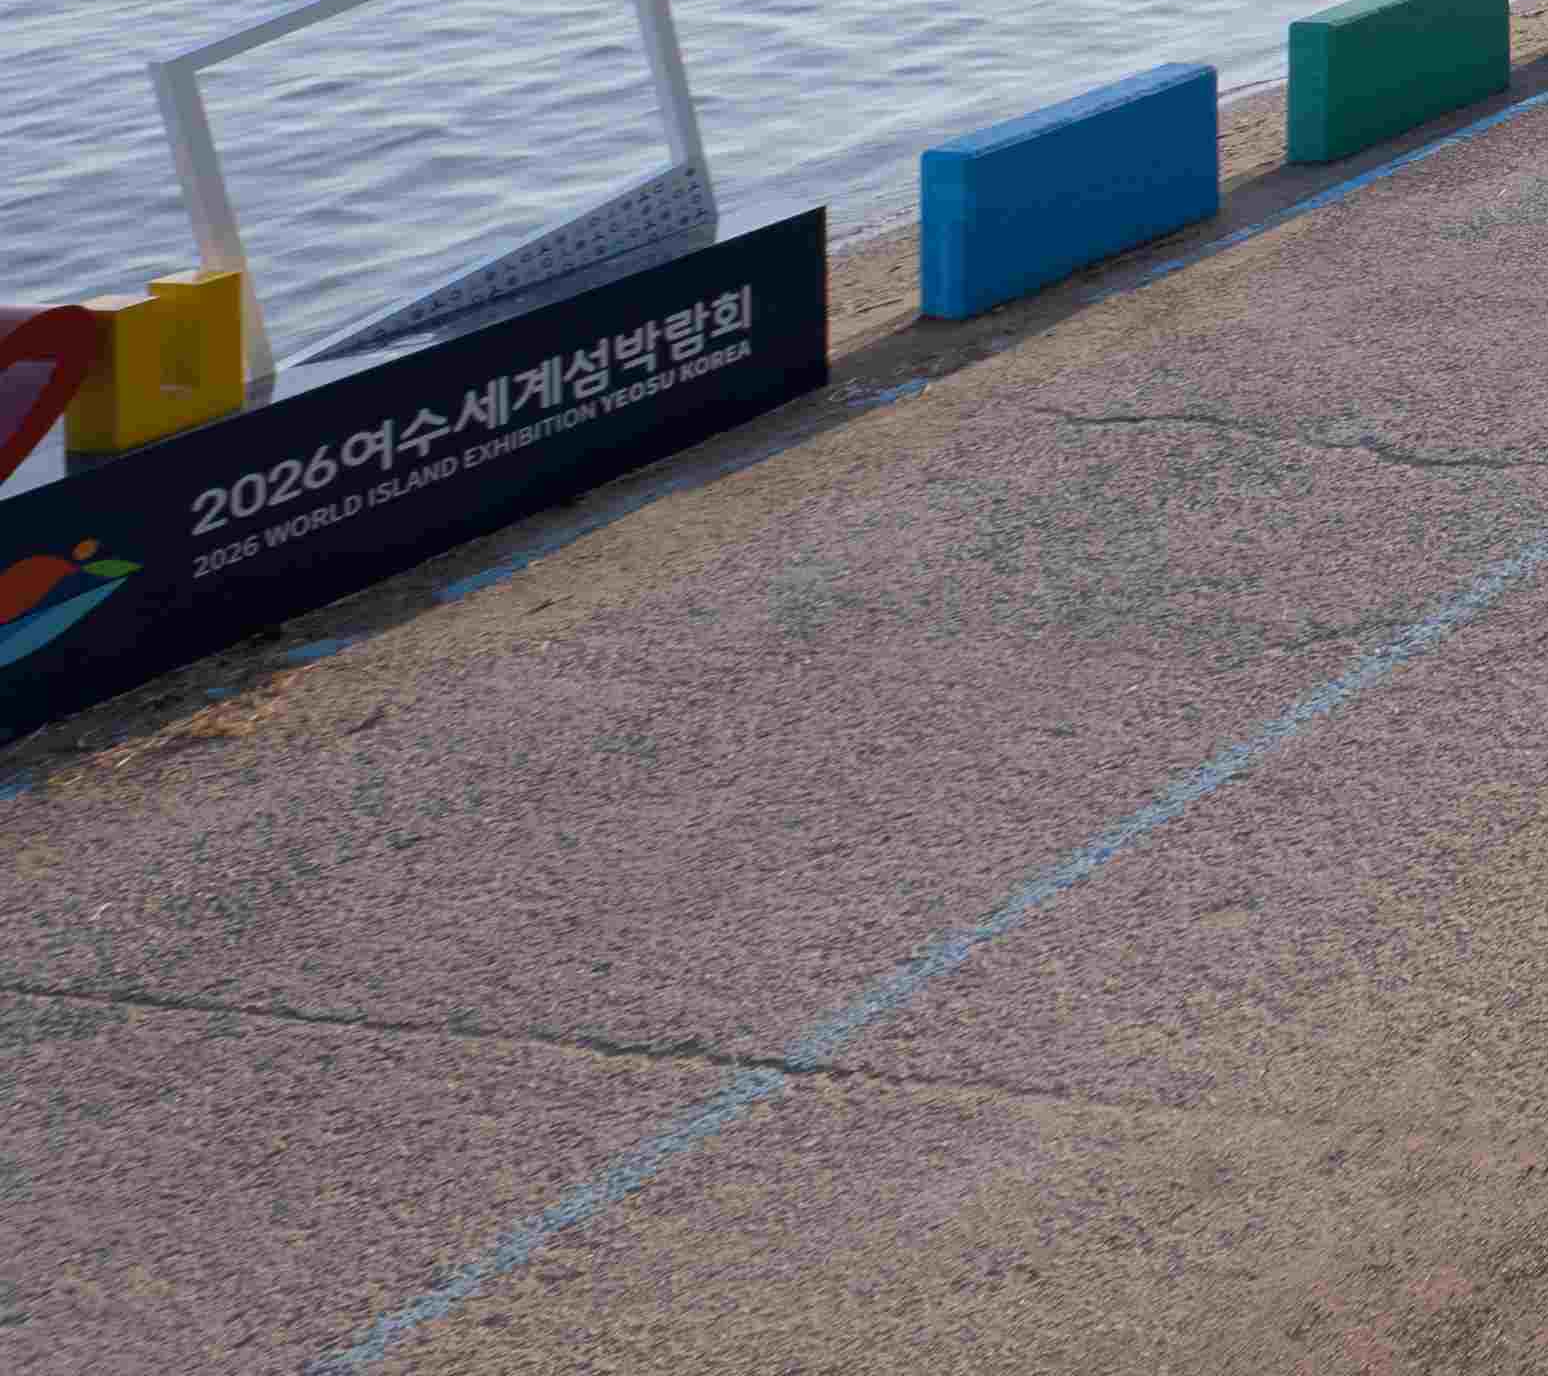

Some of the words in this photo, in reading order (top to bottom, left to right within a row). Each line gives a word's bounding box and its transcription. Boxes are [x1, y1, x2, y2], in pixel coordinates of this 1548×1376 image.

[192, 535, 260, 579] 2026
[264, 494, 363, 547] WORLD
[368, 455, 459, 507] ISLAND
[463, 402, 597, 470] EXHIBITION
[601, 369, 676, 414] YEOSU
[680, 338, 751, 383] KOREA
